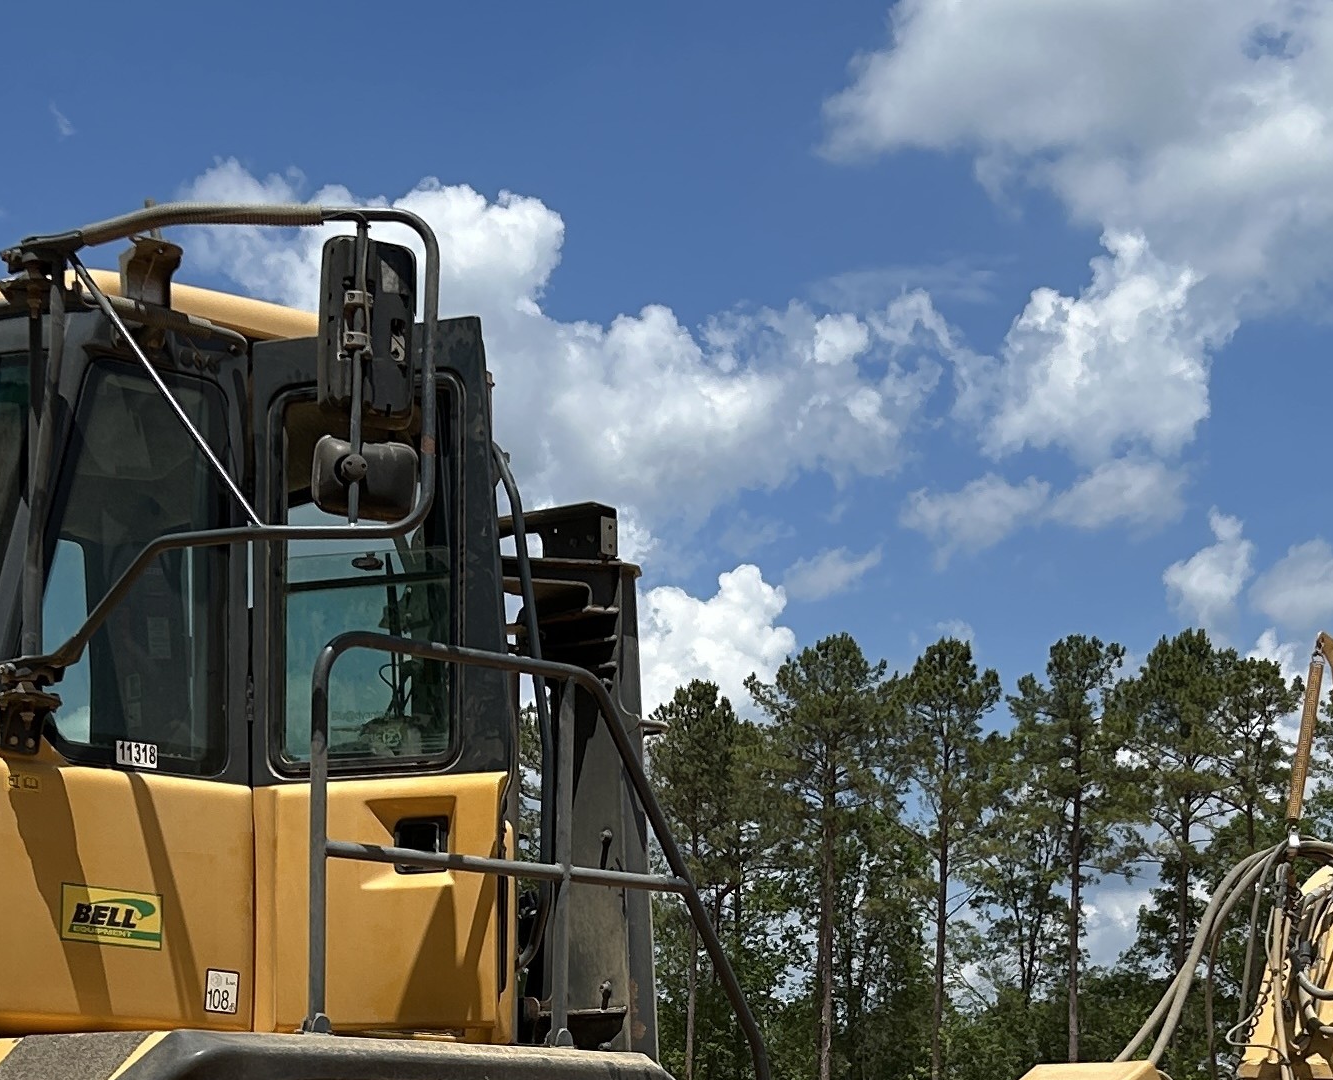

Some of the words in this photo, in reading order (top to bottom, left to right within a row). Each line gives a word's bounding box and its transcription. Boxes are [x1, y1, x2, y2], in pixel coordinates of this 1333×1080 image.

[119, 741, 156, 765] 11318
[72, 903, 137, 928] BELL
[208, 988, 229, 1010] 108
